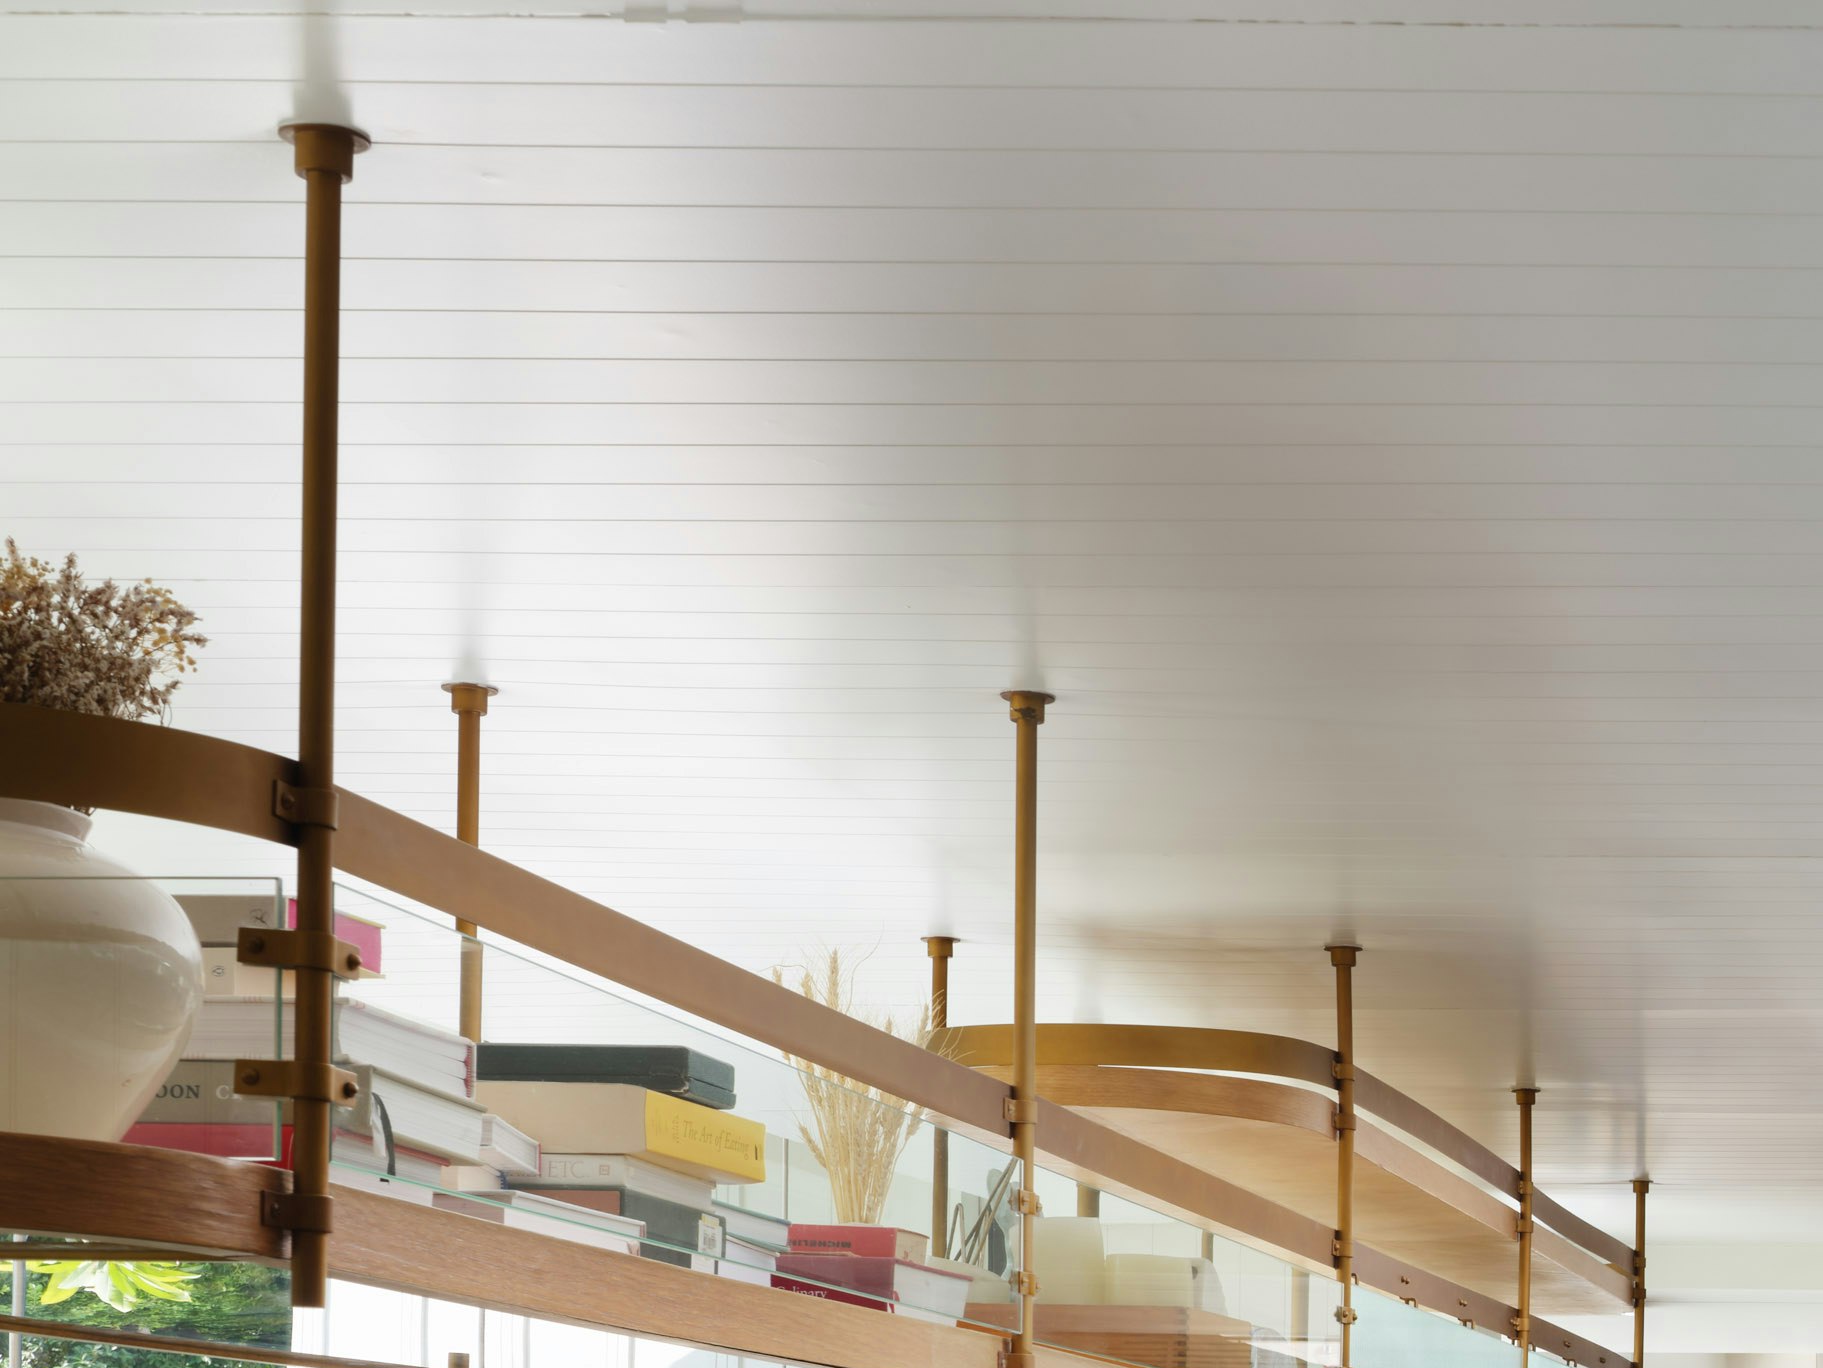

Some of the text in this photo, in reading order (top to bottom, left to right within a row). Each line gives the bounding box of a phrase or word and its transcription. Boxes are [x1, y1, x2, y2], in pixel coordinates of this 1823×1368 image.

[683, 1119, 699, 1140] The
[699, 1126, 713, 1144] Art
[714, 1129, 723, 1152] of
[724, 1130, 750, 1160] Eating
[777, 1285, 828, 1299] linary
